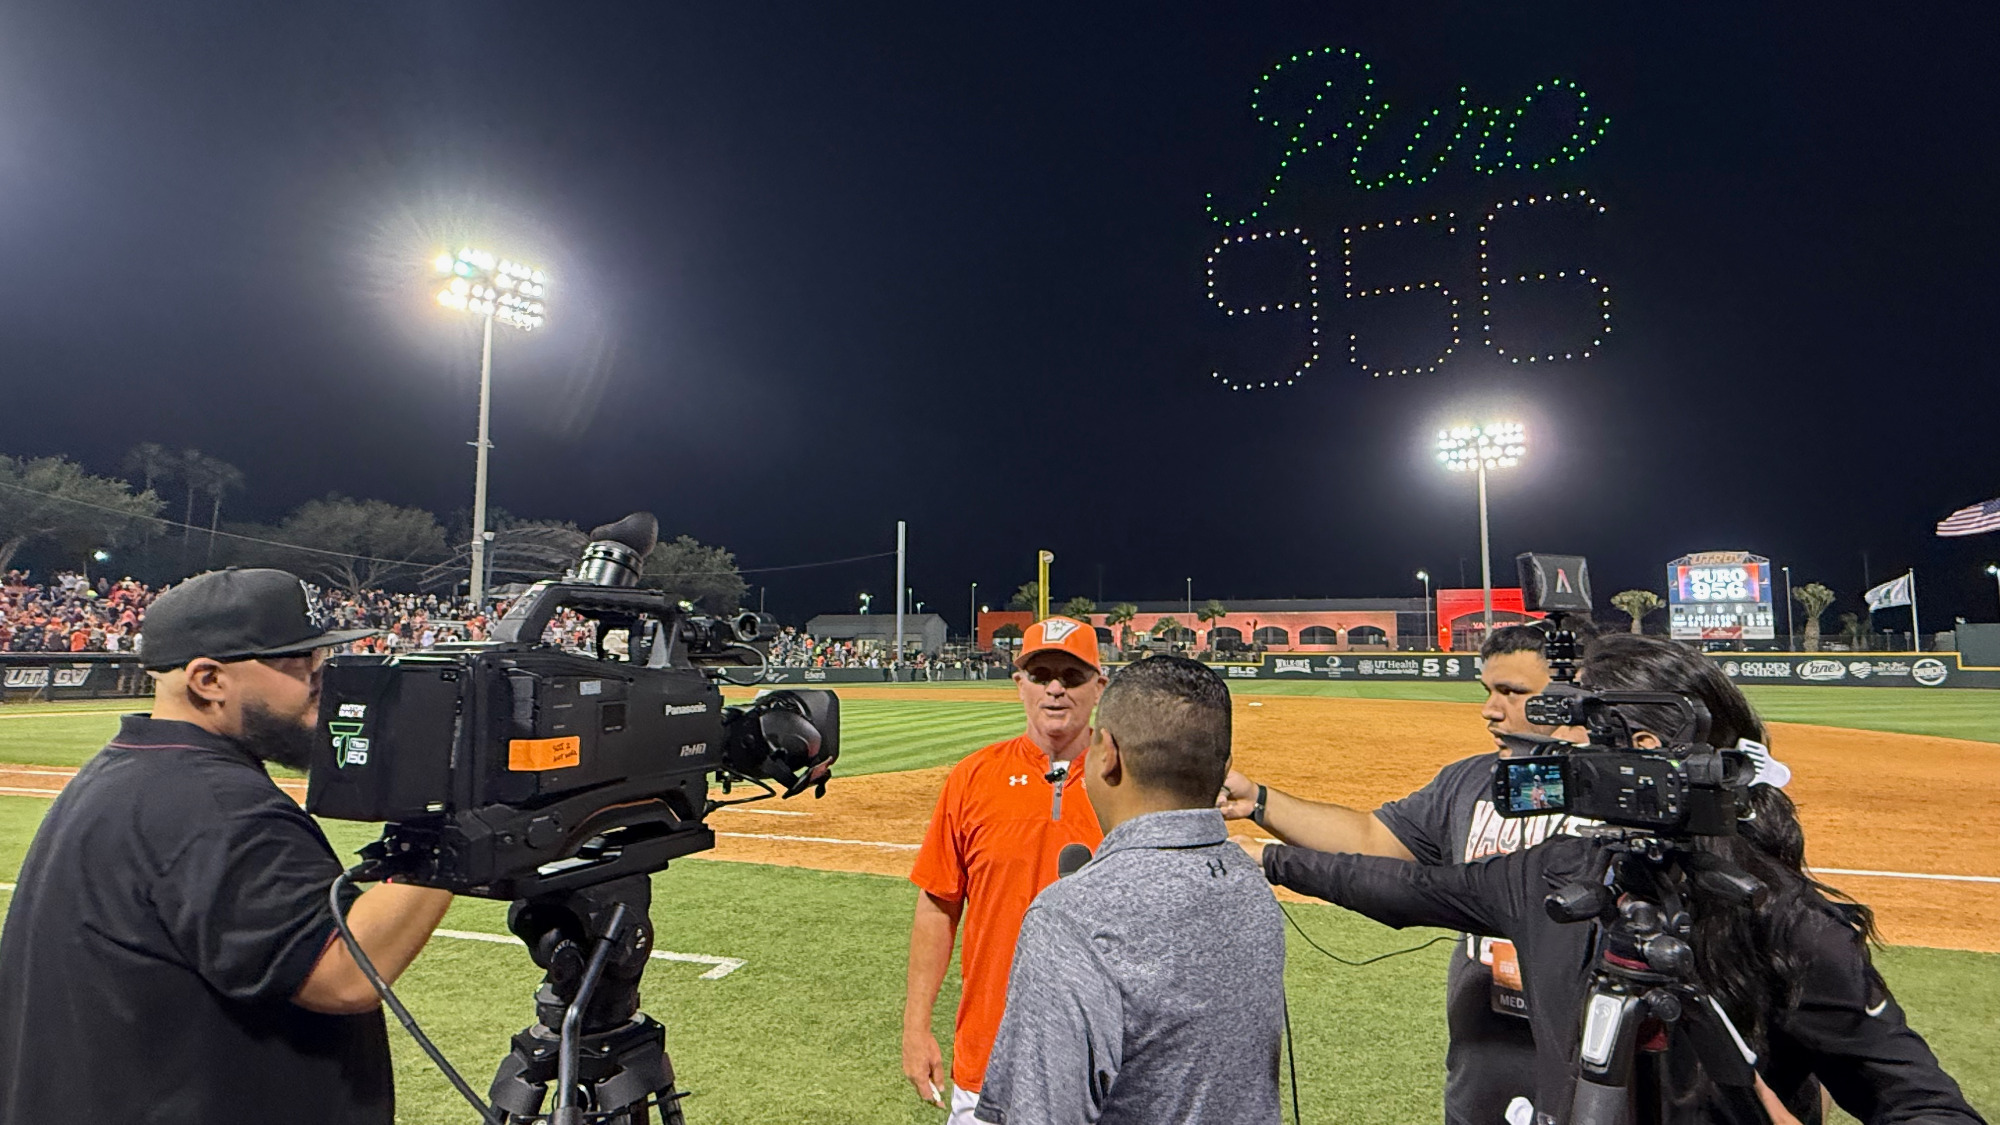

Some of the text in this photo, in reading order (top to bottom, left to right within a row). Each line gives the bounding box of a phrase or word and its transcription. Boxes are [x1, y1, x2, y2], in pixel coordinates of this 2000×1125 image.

[1207, 191, 1612, 391] 956
[1688, 568, 1747, 585] PURO
[1692, 581, 1748, 600] 956
[1374, 659, 1419, 669] UT Health
[1422, 658, 1441, 673] 5
[665, 702, 707, 716] Panasonic
[1500, 994, 1527, 1010] MED
